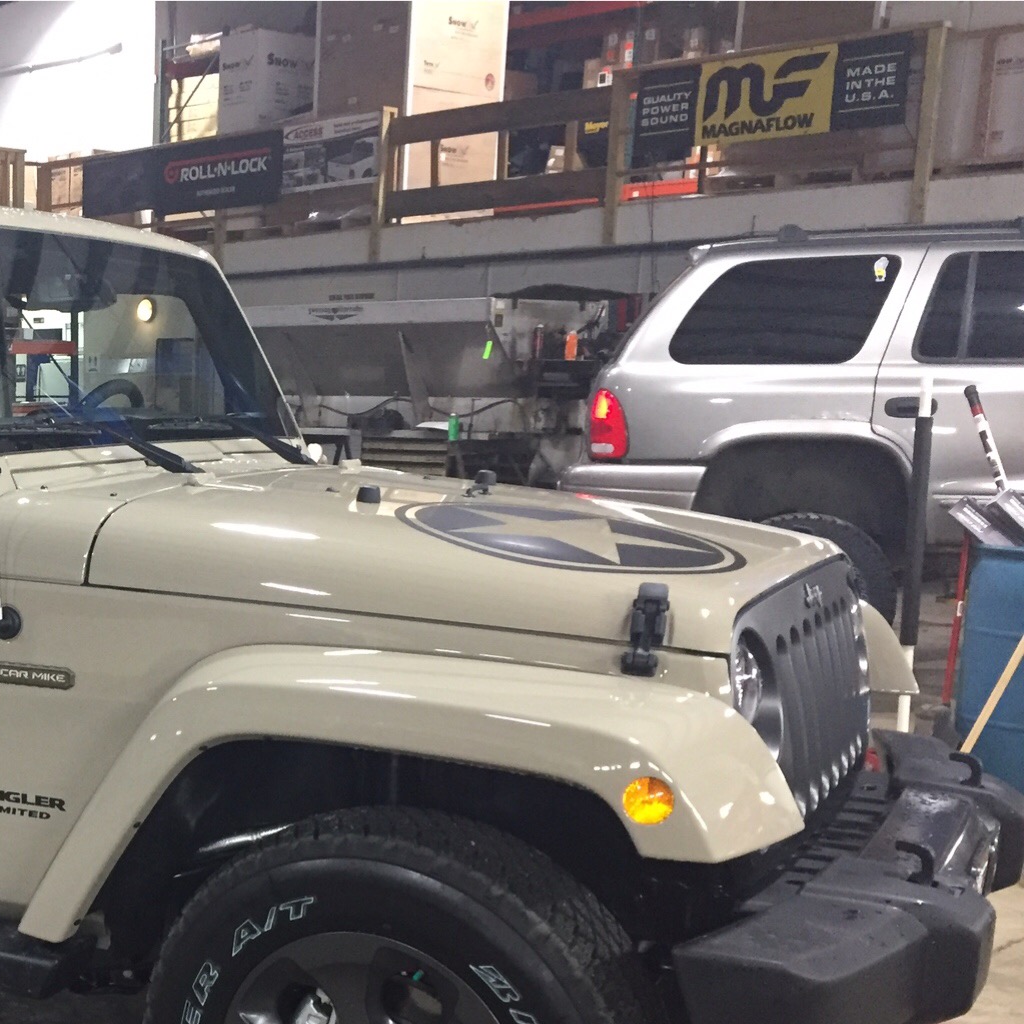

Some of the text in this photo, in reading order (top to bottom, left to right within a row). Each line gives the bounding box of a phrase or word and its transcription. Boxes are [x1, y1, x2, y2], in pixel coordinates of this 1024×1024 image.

[846, 63, 898, 78] MADE
[845, 76, 897, 91] IN THE
[642, 90, 693, 106] QUALITY
[844, 88, 895, 104] U.S.A.
[641, 102, 690, 116] POWER
[640, 113, 689, 127] SOUND
[701, 112, 815, 140] MAGNAFLOW
[31, 672, 66, 683] MIKE
[231, 896, 315, 957] A/T
